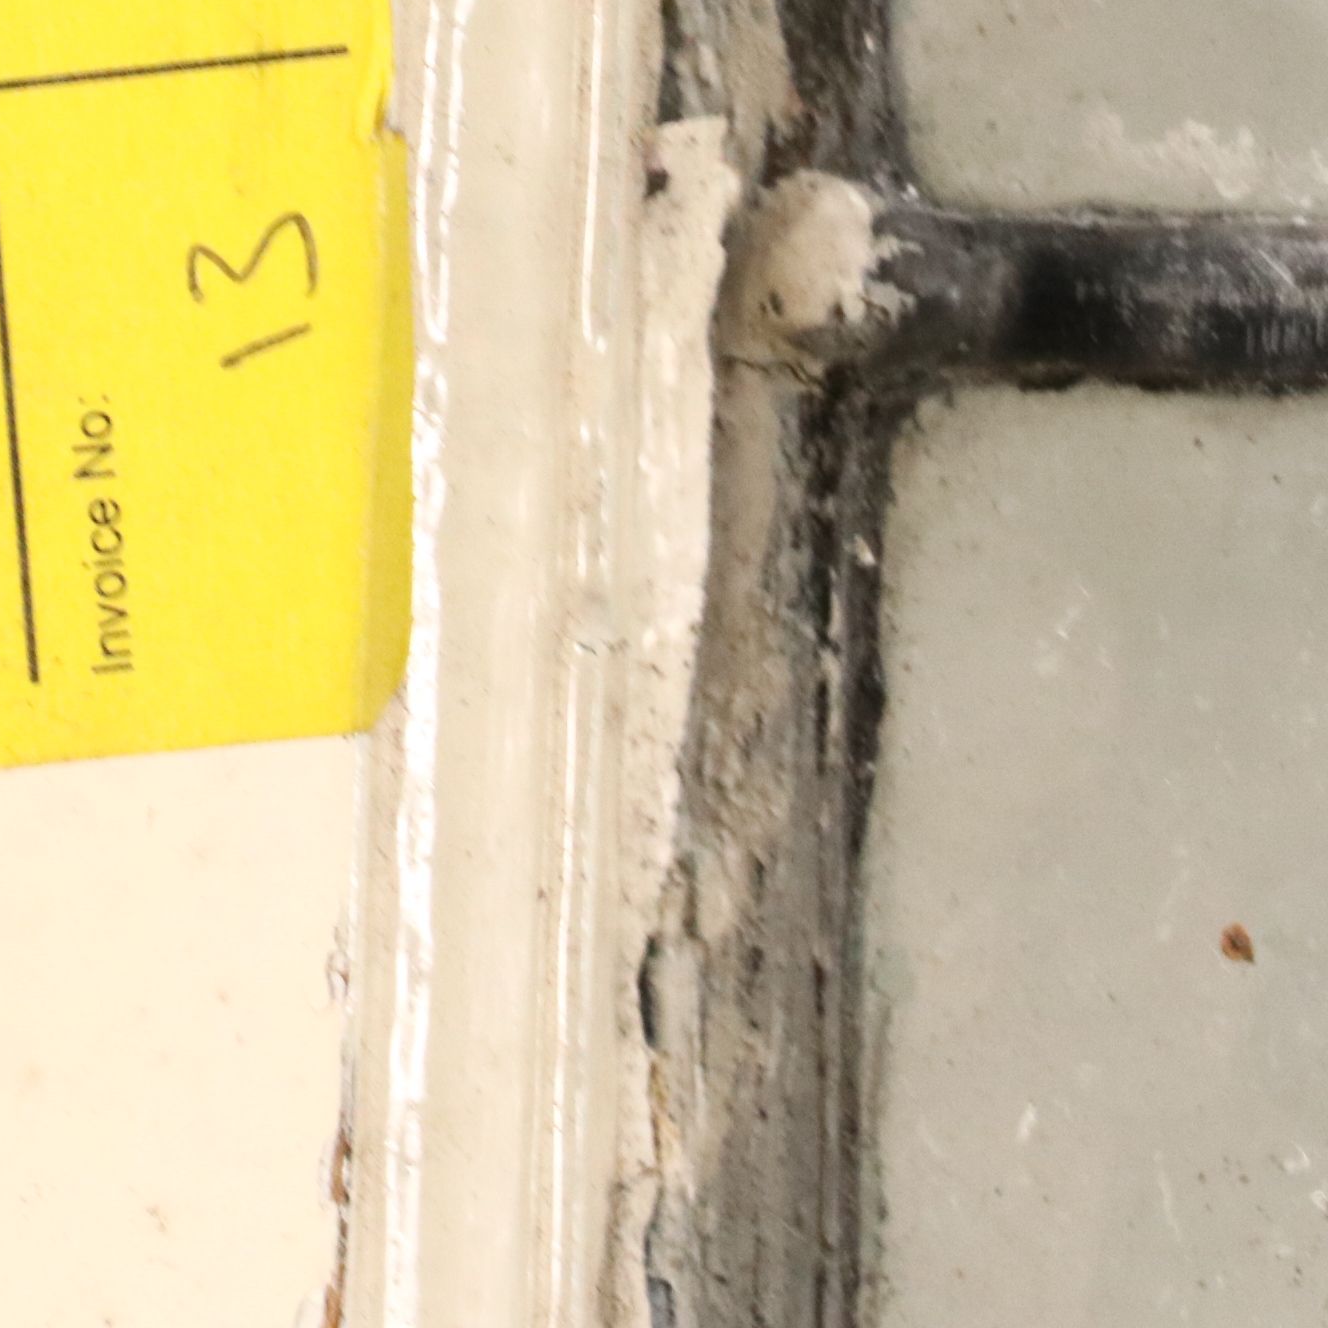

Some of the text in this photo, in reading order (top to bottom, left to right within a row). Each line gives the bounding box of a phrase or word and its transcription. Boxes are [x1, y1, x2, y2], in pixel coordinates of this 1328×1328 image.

[187, 211, 318, 370] 13
[74, 394, 133, 676] Invoice No:
